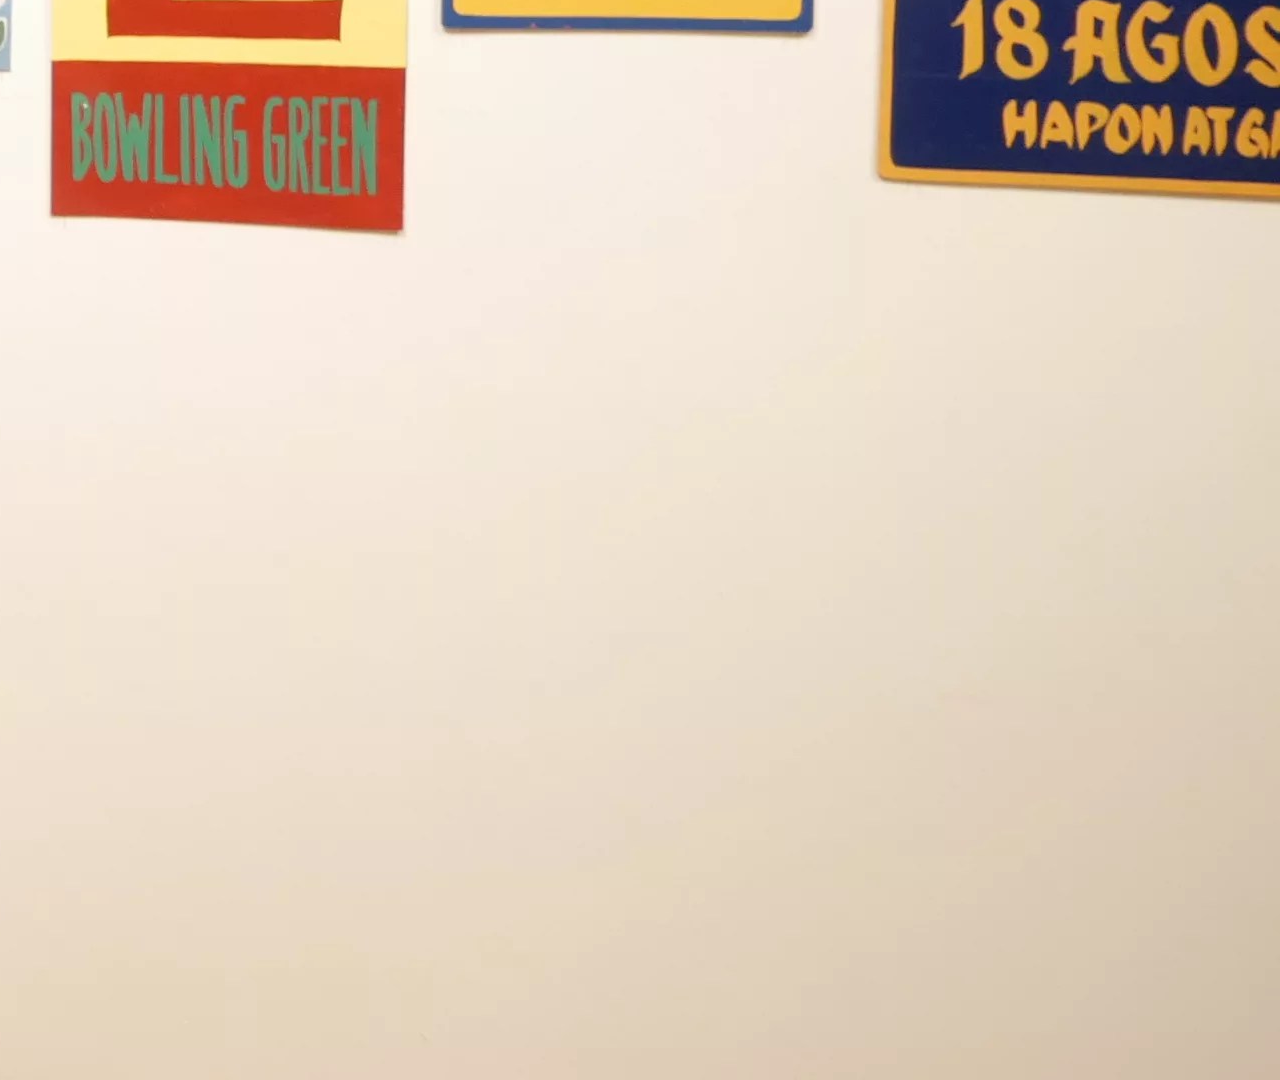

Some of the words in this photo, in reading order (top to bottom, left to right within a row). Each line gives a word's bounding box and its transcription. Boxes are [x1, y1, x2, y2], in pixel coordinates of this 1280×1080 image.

[70, 91, 247, 190] BOWLING
[263, 94, 379, 196] GREEN
[1002, 98, 1174, 155] HAPON
[1182, 105, 1236, 156] AT
[1235, 106, 1280, 160] G
